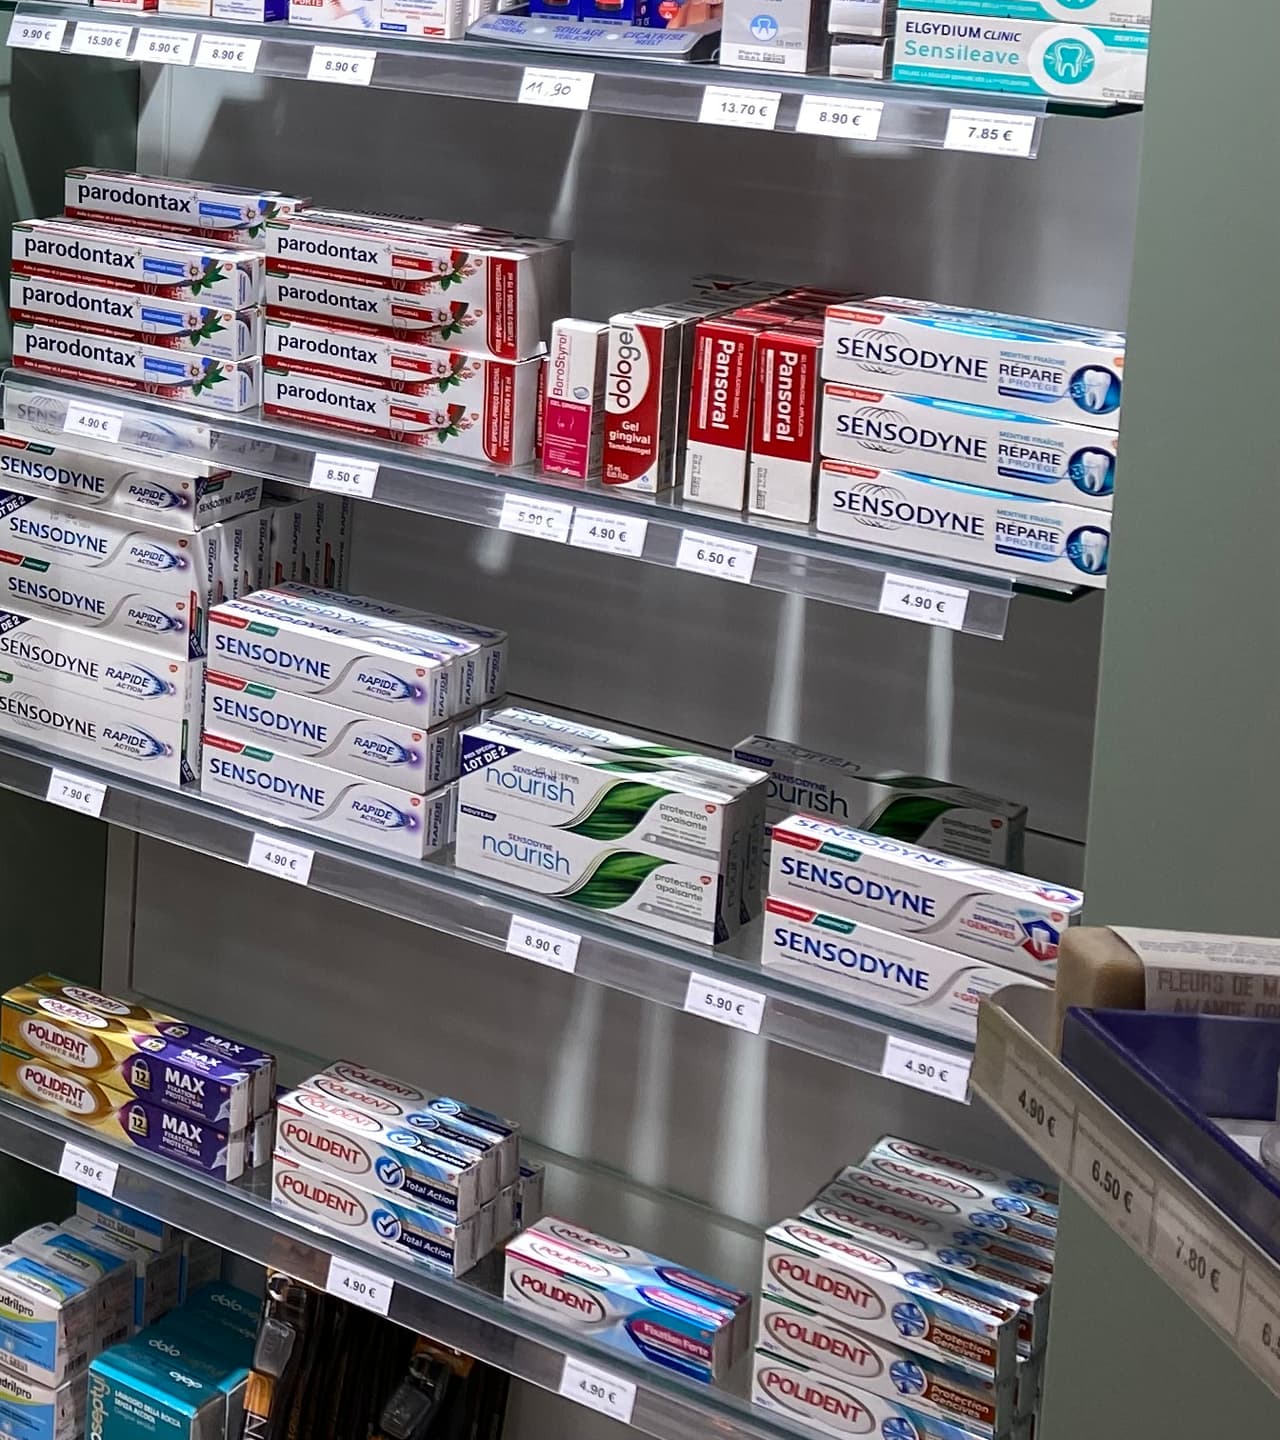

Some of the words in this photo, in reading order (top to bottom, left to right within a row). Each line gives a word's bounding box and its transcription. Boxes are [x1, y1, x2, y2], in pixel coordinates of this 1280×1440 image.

[22, 29, 42, 39] 9.90
[44, 31, 50, 40] €
[87, 35, 111, 47] 15.90
[113, 37, 121, 47] €
[553, 26, 605, 36] SOULAGE
[623, 32, 686, 41] CICATRISE
[905, 21, 981, 38] ELGYDIUM
[983, 30, 1022, 42] CLINIC
[212, 48, 235, 61] 8.90
[237, 51, 244, 61] €
[904, 40, 1020, 65] Sensileave
[325, 61, 348, 71] 8.90
[350, 63, 358, 72] €
[721, 102, 756, 115] 13.70
[758, 106, 767, 117] €
[819, 111, 847, 125] 8.90
[852, 115, 861, 126] €
[968, 127, 999, 140] 7.85
[1003, 130, 1013, 141] €
[78, 183, 190, 214] parodontax
[25, 236, 136, 270] parodontax
[278, 236, 378, 264] parodontax
[23, 285, 134, 319] parodontax
[25, 334, 136, 368] parodontax
[836, 337, 988, 379] SENSODYNE
[552, 330, 566, 397] BoroStyrol
[609, 324, 641, 409] dologel
[999, 363, 1063, 385] RÉPARE
[711, 338, 736, 430] Pansoral
[776, 350, 798, 442] Pansoral
[78, 416, 100, 428] 4.90
[100, 420, 108, 431] €
[622, 421, 639, 432] Gel
[609, 430, 651, 444] gingival
[837, 414, 988, 459] SENSODYNE
[0, 456, 105, 494] SENSODYNE
[326, 470, 350, 482] 8.50
[353, 474, 360, 484] €
[6, 501, 19, 513] DE
[16, 495, 26, 506] 2
[128, 485, 165, 501] RAPIDE
[136, 497, 159, 506] ACTION
[833, 490, 985, 537] SENSODYNE
[9, 517, 108, 554] SENSODYNE
[589, 525, 615, 540] 4.90
[618, 530, 627, 542] €
[130, 547, 165, 562] RAPIDE
[697, 549, 725, 565] 6.50
[727, 555, 736, 567] €
[901, 593, 932, 610] 4.90
[936, 601, 945, 613] €
[128, 608, 162, 625] RAPIDE
[486, 766, 576, 807] nourish
[659, 802, 708, 822] protection
[660, 813, 708, 832] apaisante
[264, 851, 288, 866] 4.90
[289, 858, 297, 870] €
[482, 833, 571, 876] nourish
[965, 918, 1016, 941] GENCIVES
[524, 935, 551, 952] 8.90
[553, 944, 562, 956] €
[704, 994, 734, 1012] 5.90
[736, 1003, 745, 1017] €
[27, 1022, 88, 1055] POLIDENT
[40, 1040, 64, 1056] POWER
[65, 1052, 86, 1063] MAX
[164, 1066, 205, 1097] MAX
[904, 1058, 935, 1079] 4.90
[939, 1069, 949, 1083] €
[24, 1068, 86, 1101] POLIDENT
[167, 1085, 195, 1102] FIXATION
[165, 1089, 203, 1109] PROTECTION
[1017, 1087, 1045, 1127] 4.90
[1046, 1117, 1057, 1139] €
[162, 1113, 203, 1144] MAX
[286, 1125, 360, 1164] POLIDENT
[282, 1178, 357, 1217] POLIDENT
[406, 1180, 425, 1194] Total
[426, 1189, 456, 1206] Action
[1091, 1159, 1122, 1201] 6.50
[1123, 1192, 1134, 1214] €
[343, 1278, 366, 1294] 4.90
[368, 1286, 376, 1298] €
[643, 1323, 682, 1348] Fixation
[682, 1339, 710, 1357] Forte
[933, 1339, 983, 1362] Gencives
[579, 1379, 606, 1398] 4.90
[608, 1392, 617, 1404] €
[930, 1385, 989, 1414] Protection
